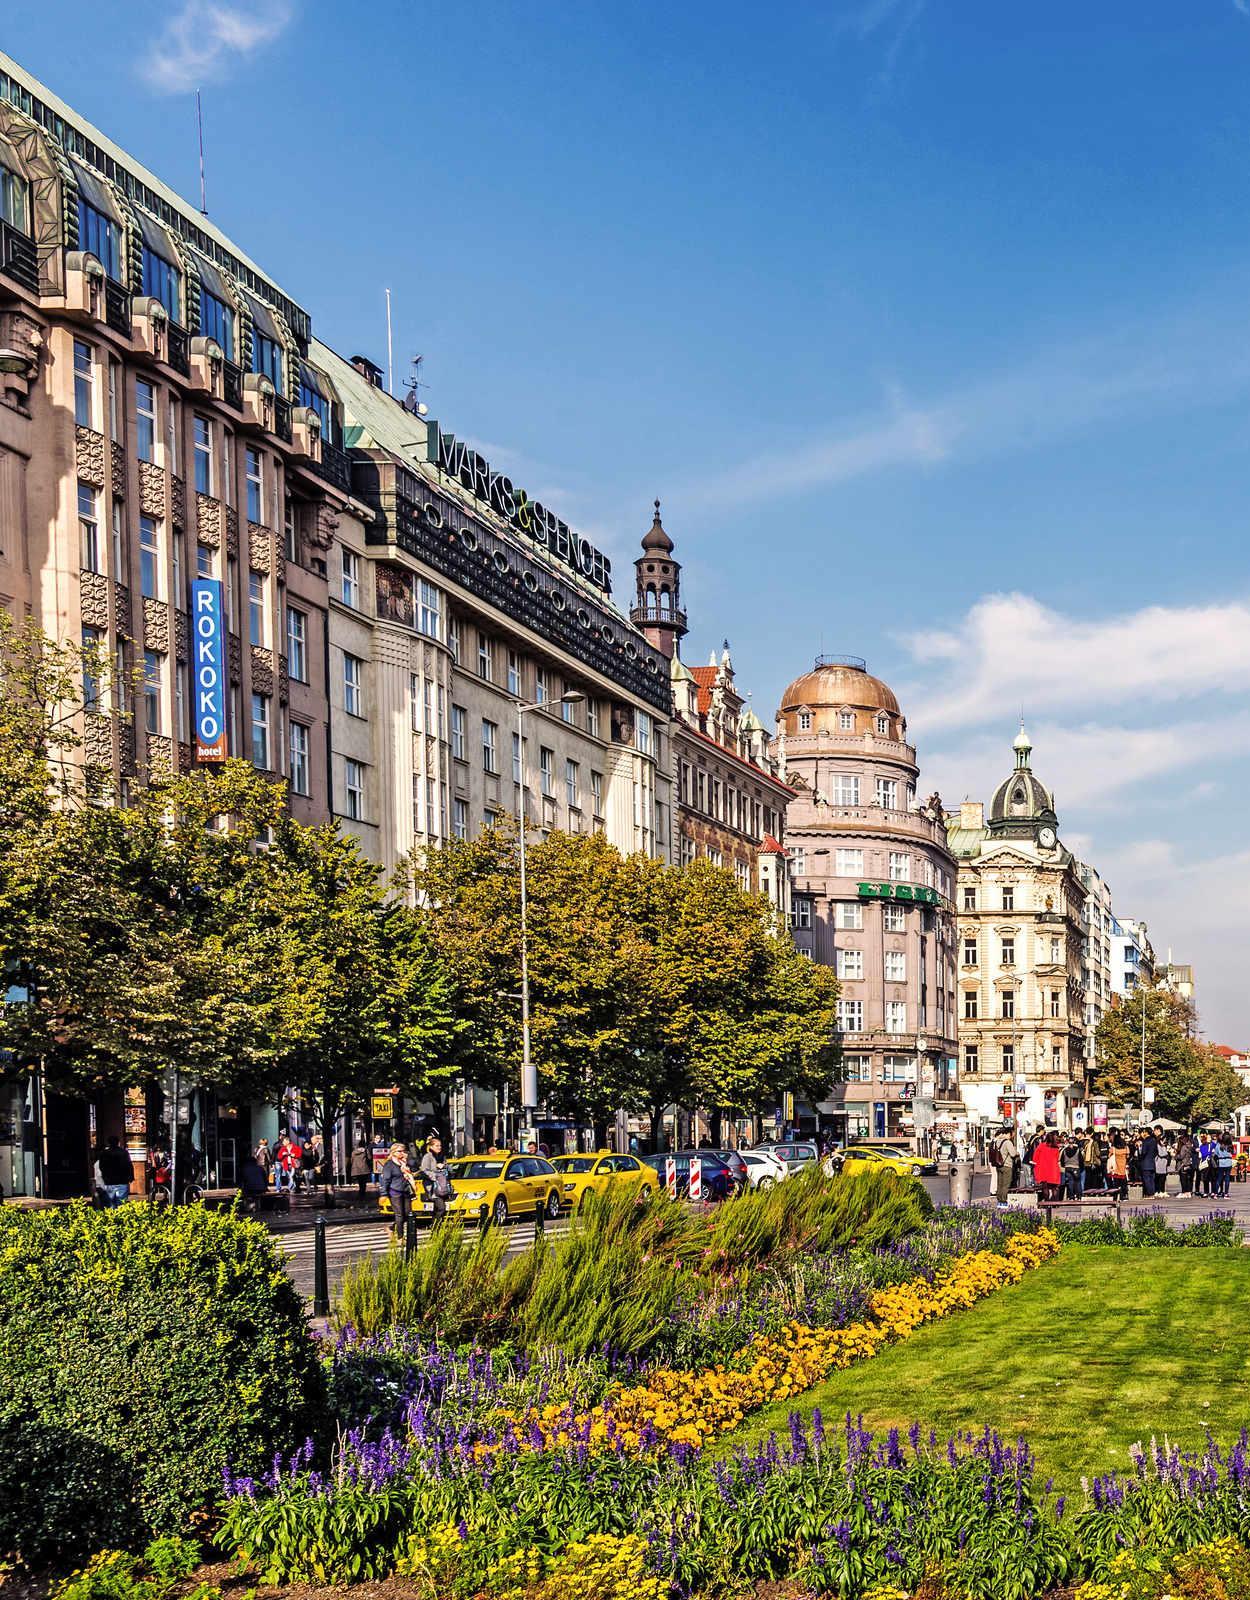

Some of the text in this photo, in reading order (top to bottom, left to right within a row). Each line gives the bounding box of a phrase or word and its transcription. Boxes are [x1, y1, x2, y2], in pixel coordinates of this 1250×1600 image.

[435, 421, 612, 594] MARKS & SPENCER
[197, 590, 218, 738] ROKOKO
[198, 746, 222, 756] hotel
[375, 1103, 389, 1113] TAXI
